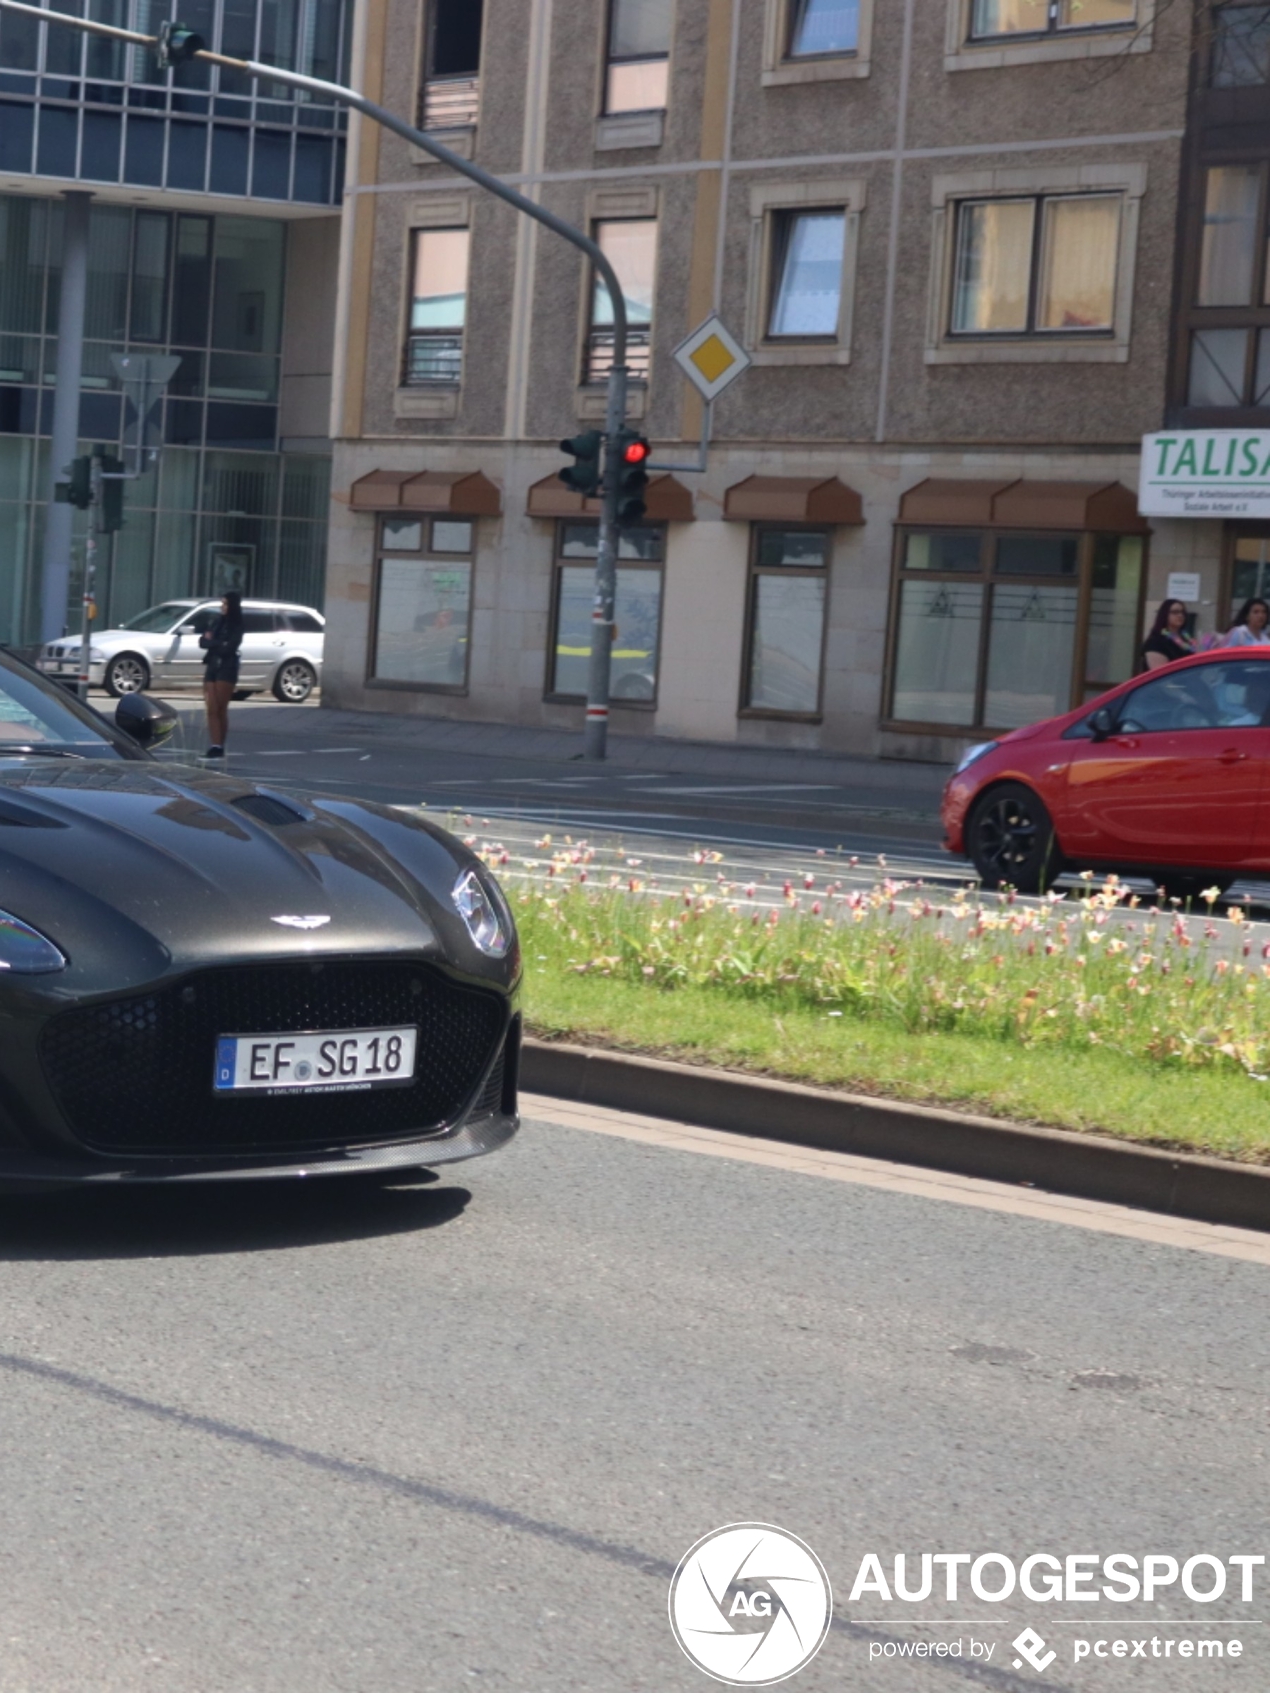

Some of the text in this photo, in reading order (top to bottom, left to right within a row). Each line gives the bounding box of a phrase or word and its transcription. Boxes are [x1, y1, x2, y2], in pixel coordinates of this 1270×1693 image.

[1162, 488, 1196, 501] Thüringer
[1184, 502, 1210, 512] Soziale
[1211, 503, 1234, 512] Arbeit
[221, 1069, 229, 1080] D
[250, 1042, 295, 1081] EF
